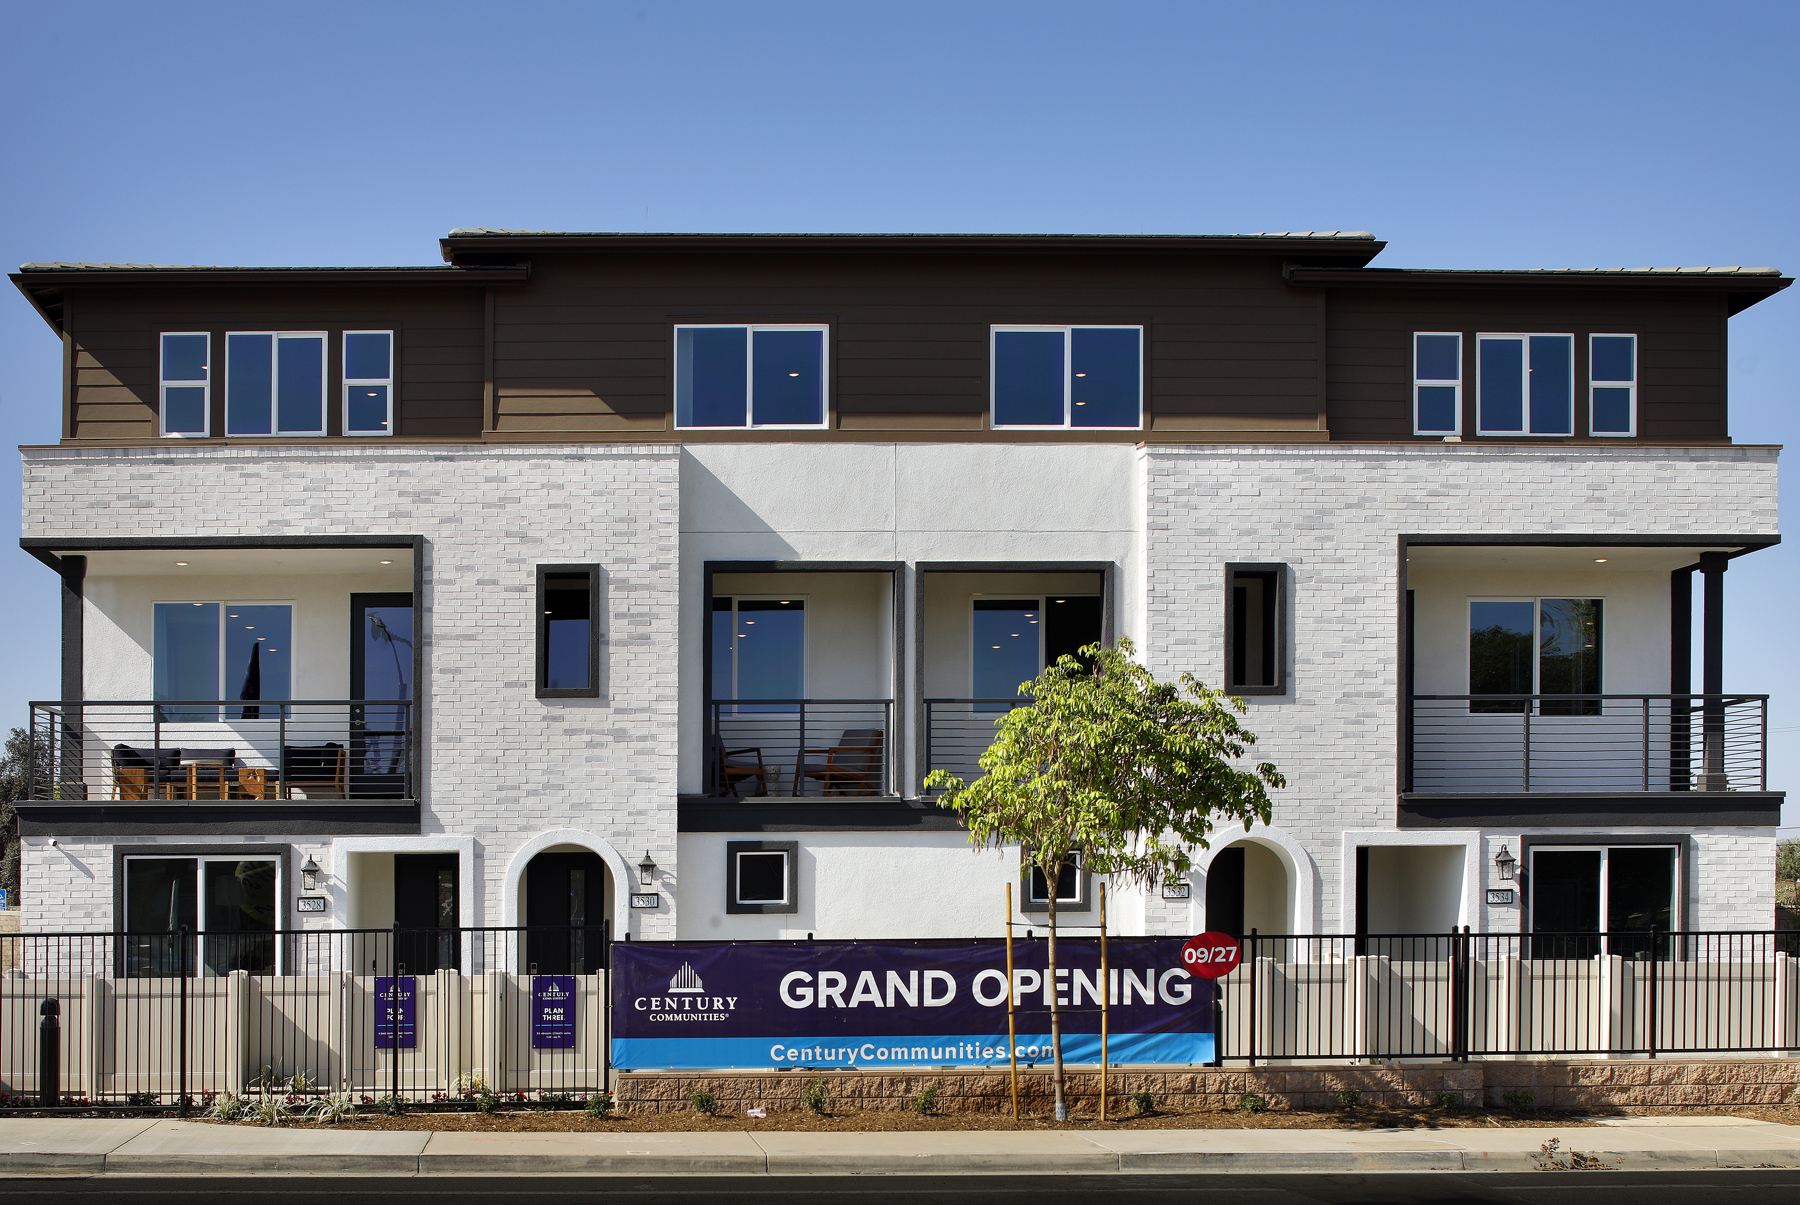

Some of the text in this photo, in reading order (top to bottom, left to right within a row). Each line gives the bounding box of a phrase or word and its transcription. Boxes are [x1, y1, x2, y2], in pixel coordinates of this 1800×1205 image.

[1166, 886, 1185, 897] 3532
[1490, 892, 1509, 902] 3534
[301, 900, 321, 910] 3528
[635, 896, 655, 906] 3530
[1184, 946, 1237, 964] 09/27
[779, 968, 1192, 1009] GRAND OPENING
[634, 997, 738, 1010] CENTURY
[770, 1042, 1054, 1064] CenturyCommunities.com
